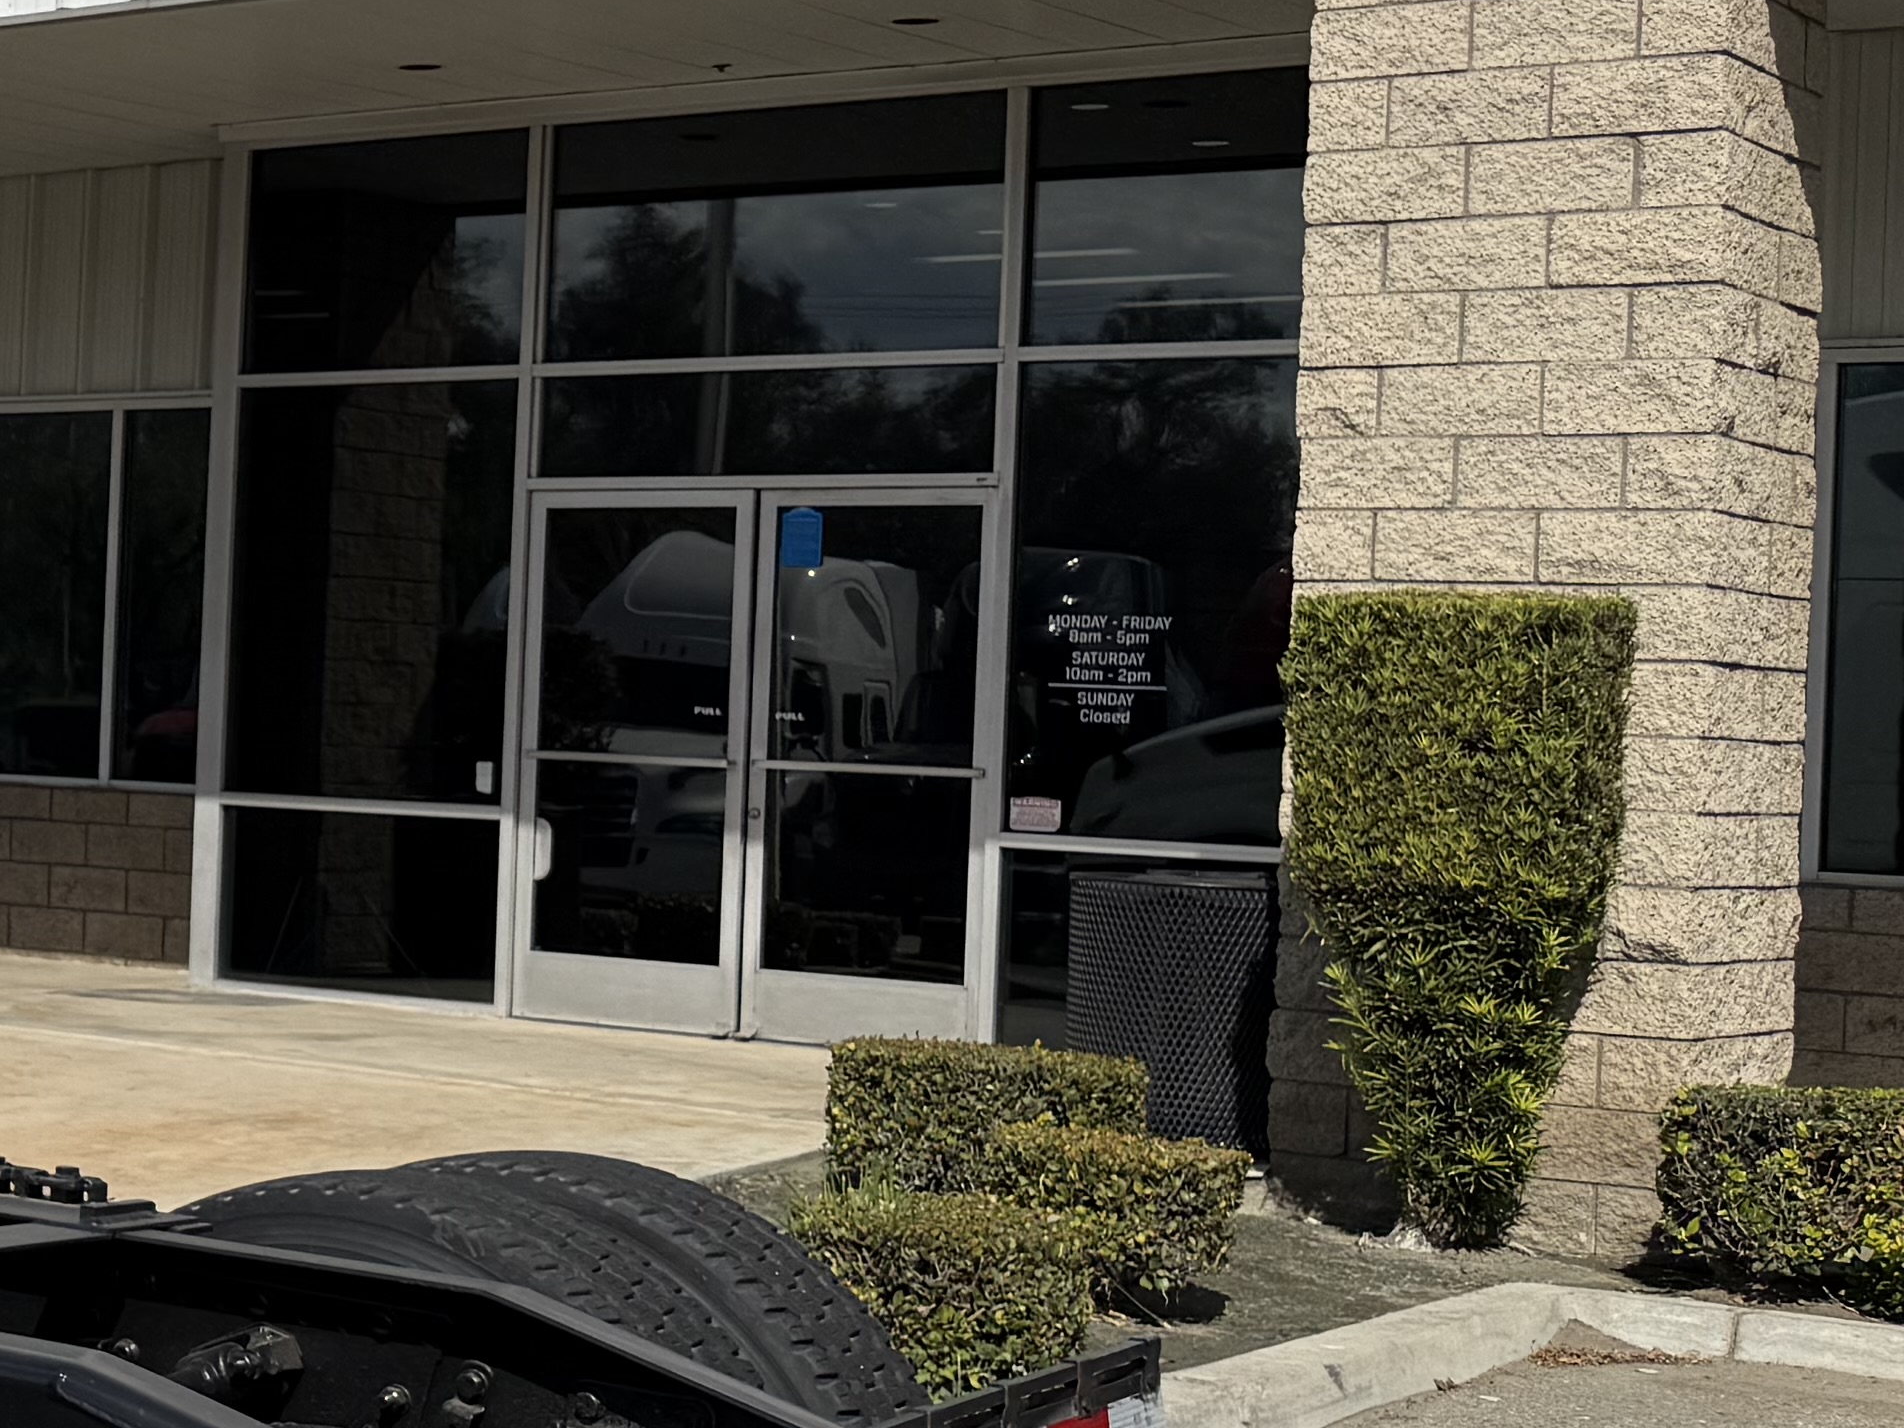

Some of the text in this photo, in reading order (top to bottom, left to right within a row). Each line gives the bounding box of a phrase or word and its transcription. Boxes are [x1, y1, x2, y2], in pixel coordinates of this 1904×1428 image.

[1048, 614, 1108, 629] MONDAY
[1122, 615, 1173, 630] FRIDAY
[1069, 629, 1102, 644] 8am
[1116, 630, 1150, 647] 5pm
[1071, 651, 1145, 666] SATURDAY
[1065, 666, 1104, 681] 10am
[1117, 668, 1151, 684] 2pm
[1077, 691, 1135, 707] SUNDAY
[694, 706, 723, 716] PULL
[775, 712, 805, 721] PULL
[1079, 708, 1131, 724] Closed
